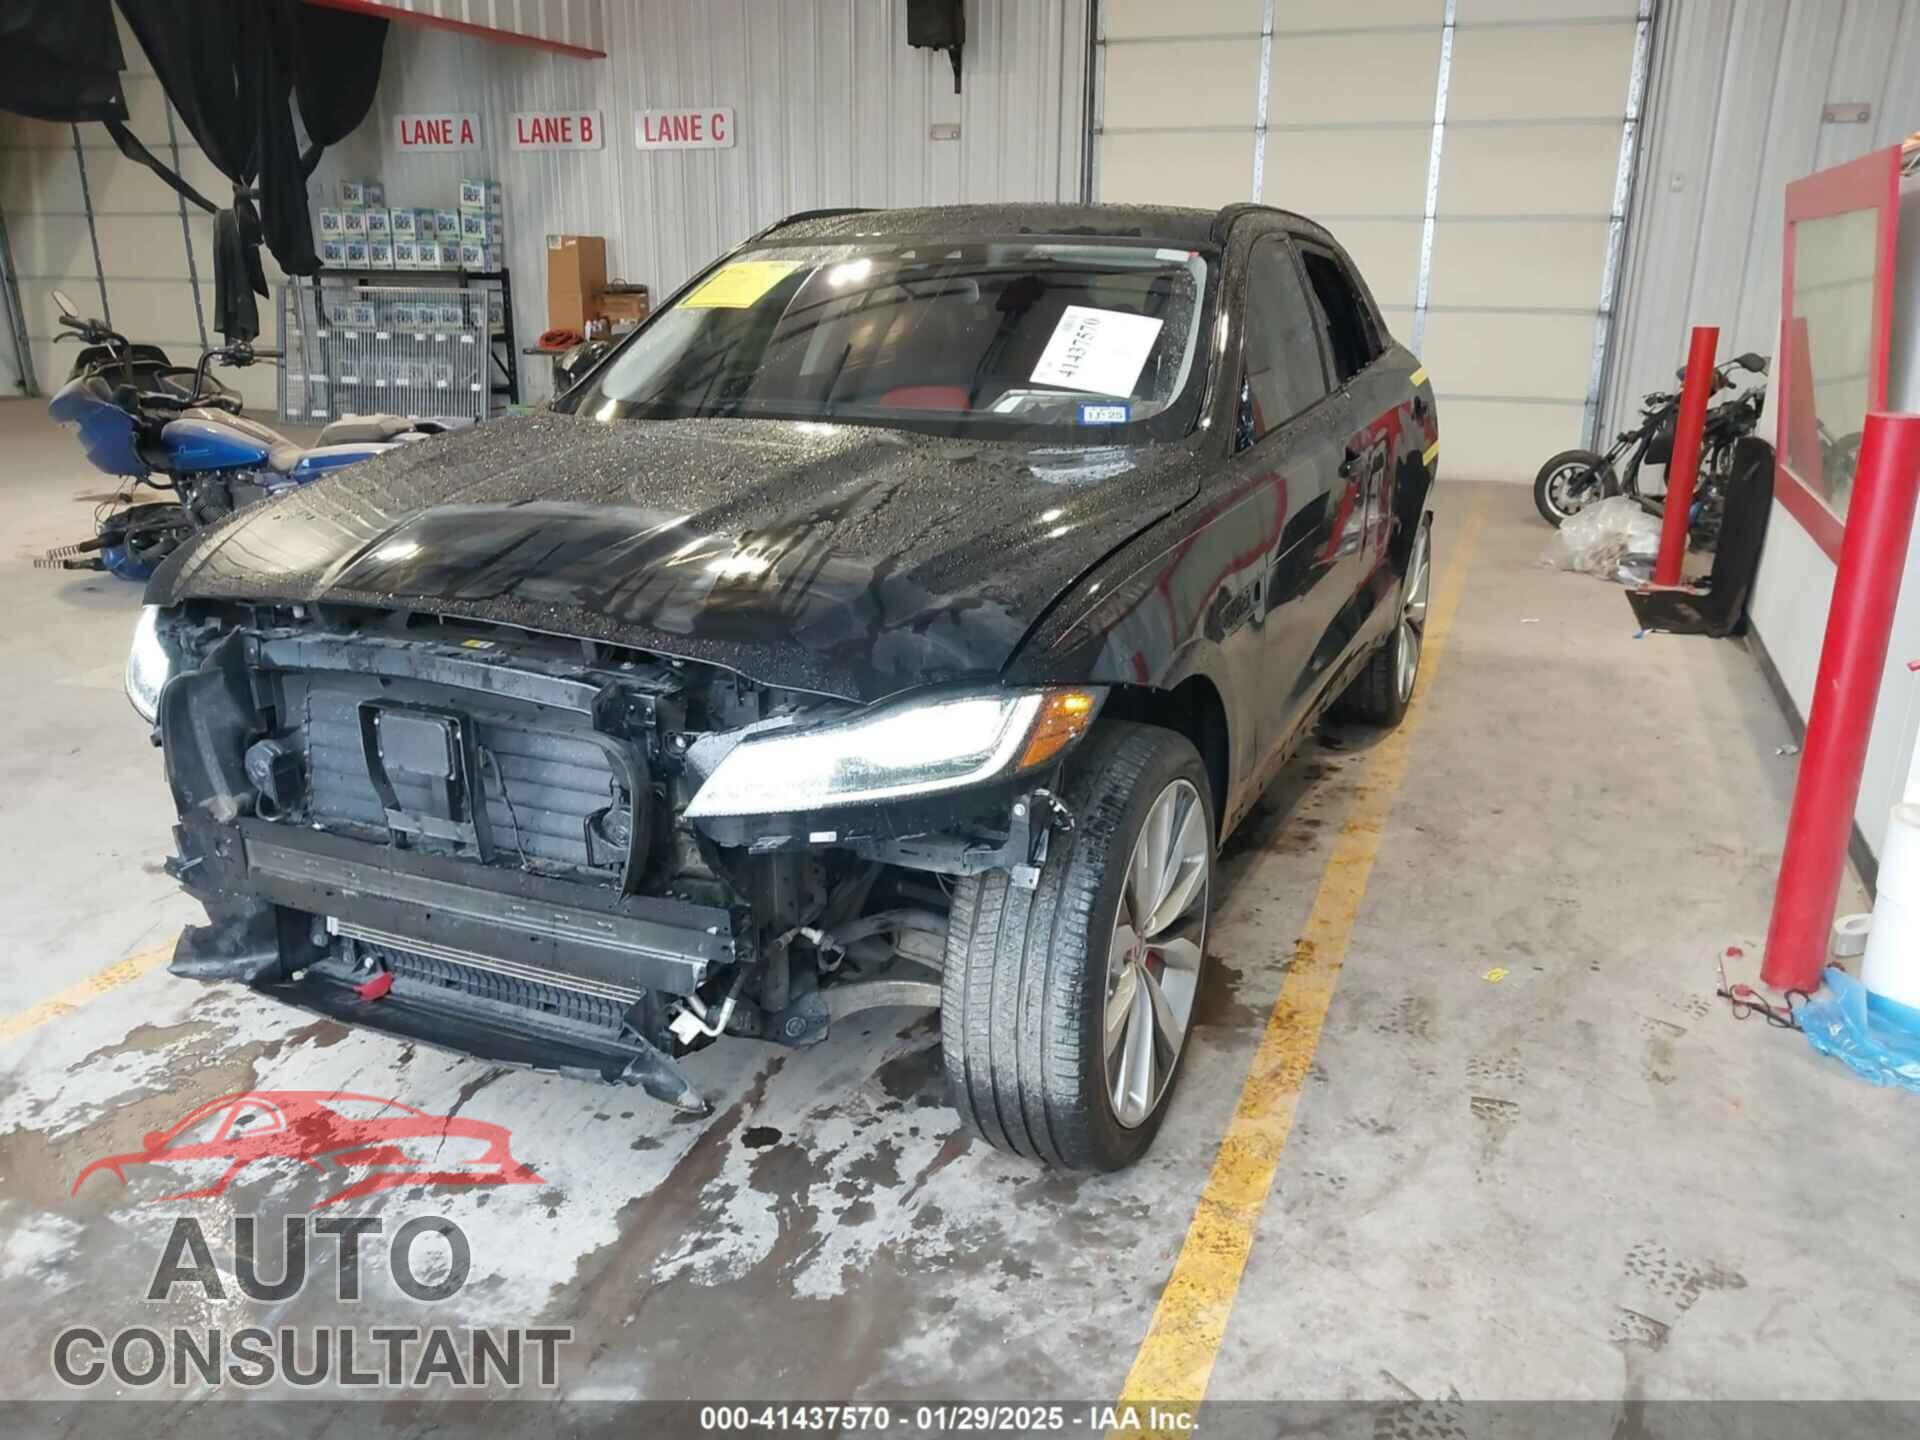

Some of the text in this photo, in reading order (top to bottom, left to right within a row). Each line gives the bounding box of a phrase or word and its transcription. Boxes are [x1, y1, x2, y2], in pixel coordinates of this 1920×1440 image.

[401, 119, 474, 145] LANE A
[518, 116, 593, 144] LANE B
[644, 113, 725, 143] LANE C
[1058, 318, 1101, 378] 41437570
